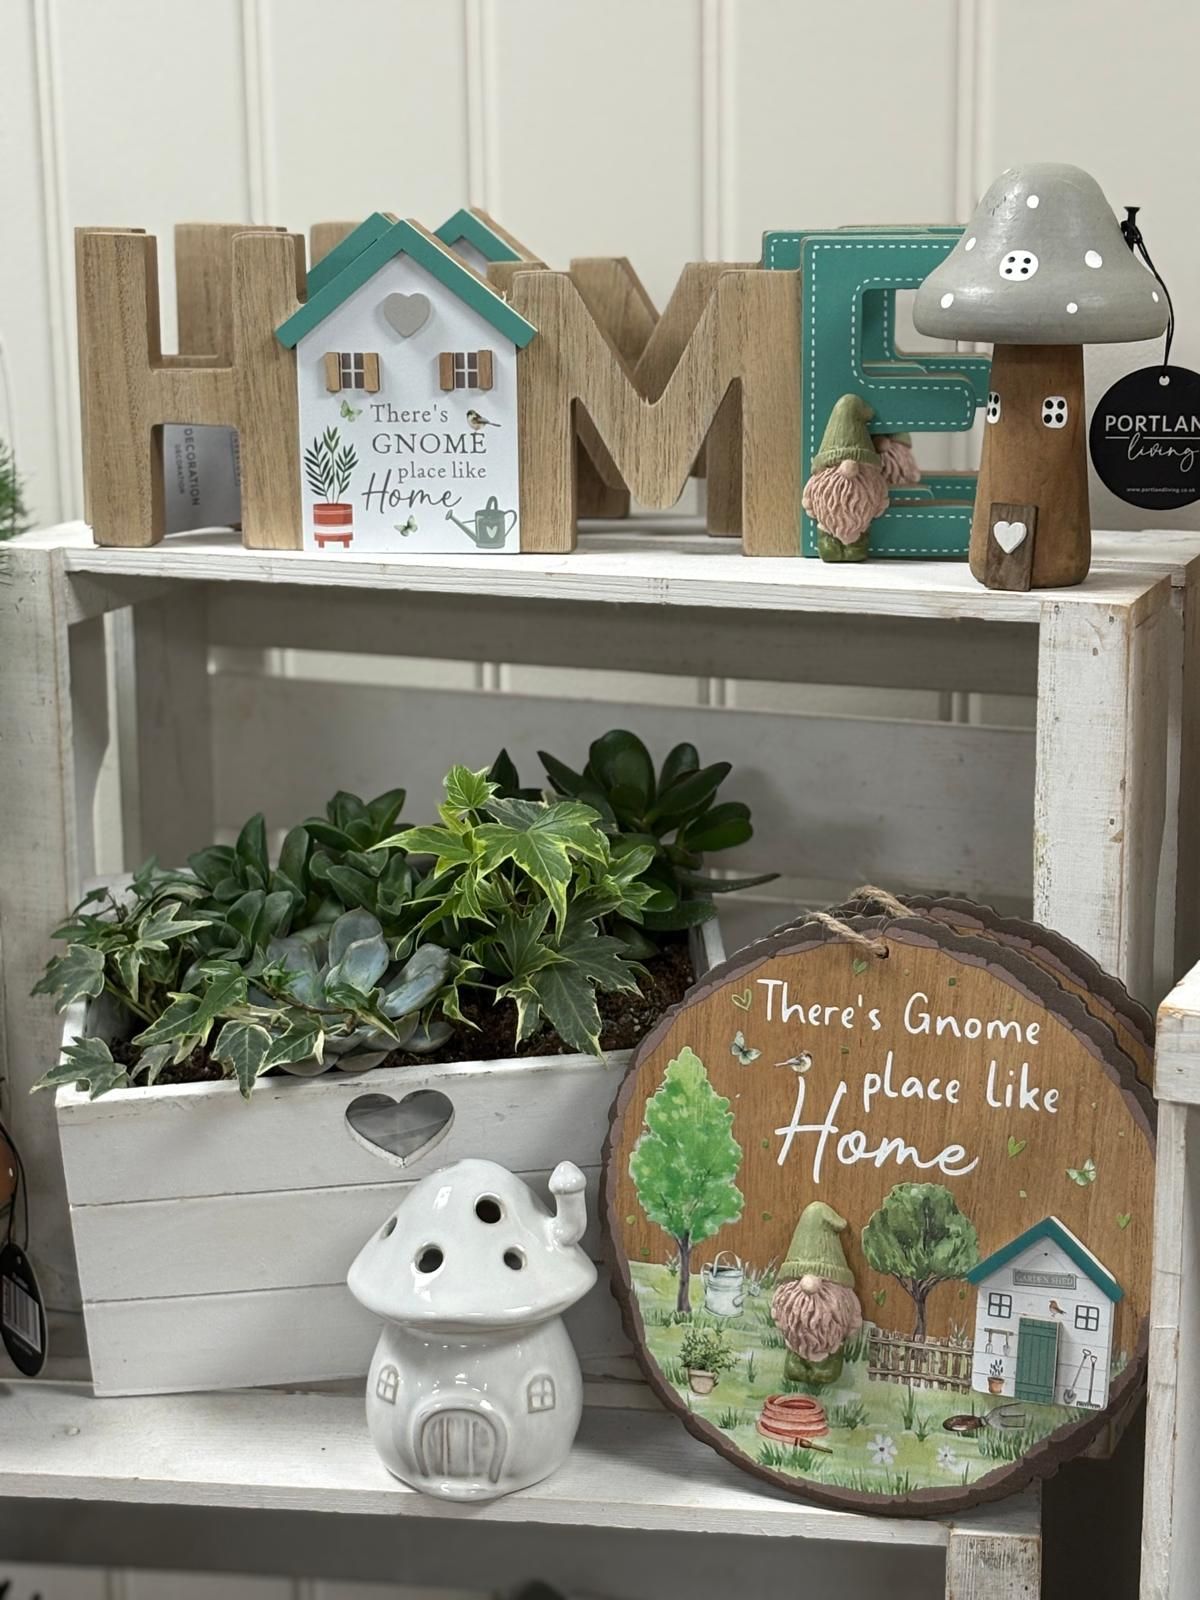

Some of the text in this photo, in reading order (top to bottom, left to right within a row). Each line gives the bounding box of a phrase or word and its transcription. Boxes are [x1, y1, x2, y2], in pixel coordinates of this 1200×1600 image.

[370, 403, 449, 423] There's
[372, 432, 487, 454] GNOME
[1127, 432, 1200, 473] living
[183, 427, 201, 506] DECORATION
[398, 460, 487, 484] place like
[361, 468, 462, 514] Home
[756, 978, 1041, 1045] There's Gnome
[863, 1050, 1059, 1114] place like
[774, 1076, 979, 1184] Home
